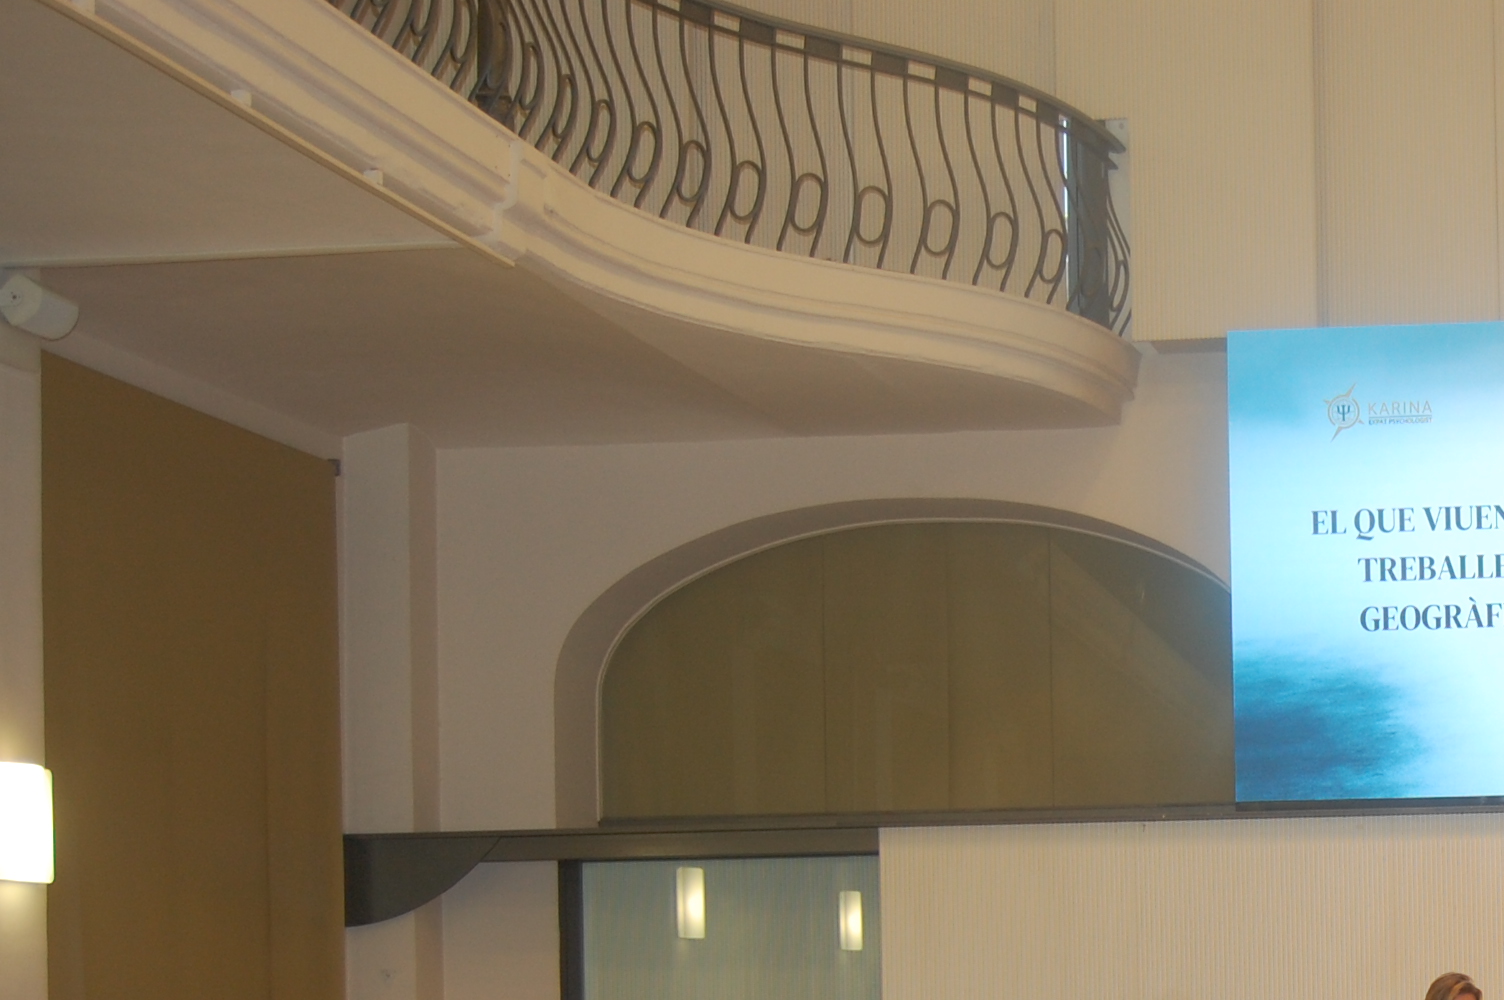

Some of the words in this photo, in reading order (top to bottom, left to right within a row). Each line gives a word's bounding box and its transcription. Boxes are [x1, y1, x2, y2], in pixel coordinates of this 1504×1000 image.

[1368, 400, 1432, 415] KARINA
[1388, 417, 1433, 425] PSYCHOLOGIST
[1311, 509, 1347, 535] EL
[1353, 507, 1416, 541] QUE
